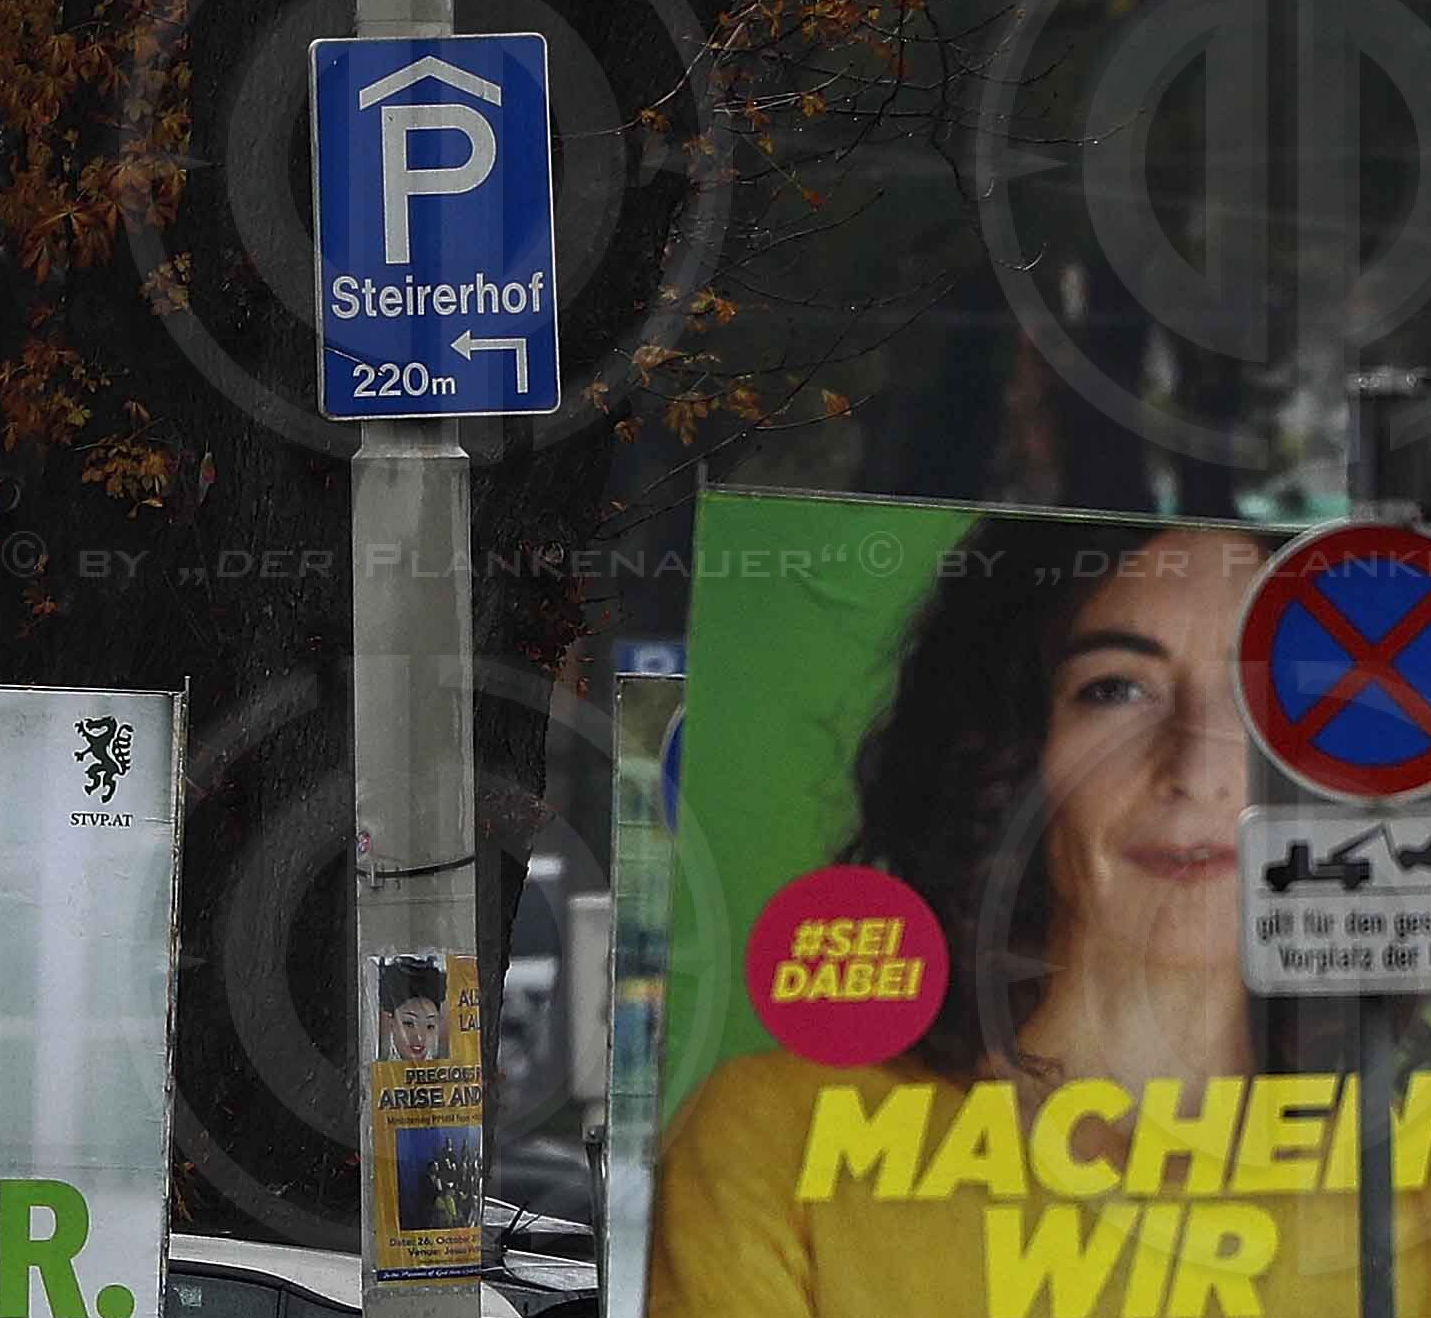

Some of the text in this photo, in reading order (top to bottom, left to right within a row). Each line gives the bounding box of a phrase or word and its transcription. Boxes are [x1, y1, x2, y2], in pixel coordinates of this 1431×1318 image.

[380, 104, 497, 264] P
[330, 272, 543, 319] Steirerhof
[352, 363, 456, 397] 220m
[70, 812, 133, 828] STVP.AT
[1344, 908, 1386, 934] den
[793, 917, 906, 961] #SEI
[1278, 943, 1372, 975] Vorplatz
[1382, 942, 1419, 971] der
[771, 956, 926, 1003] DABEI
[379, 1086, 445, 1110] ARISE
